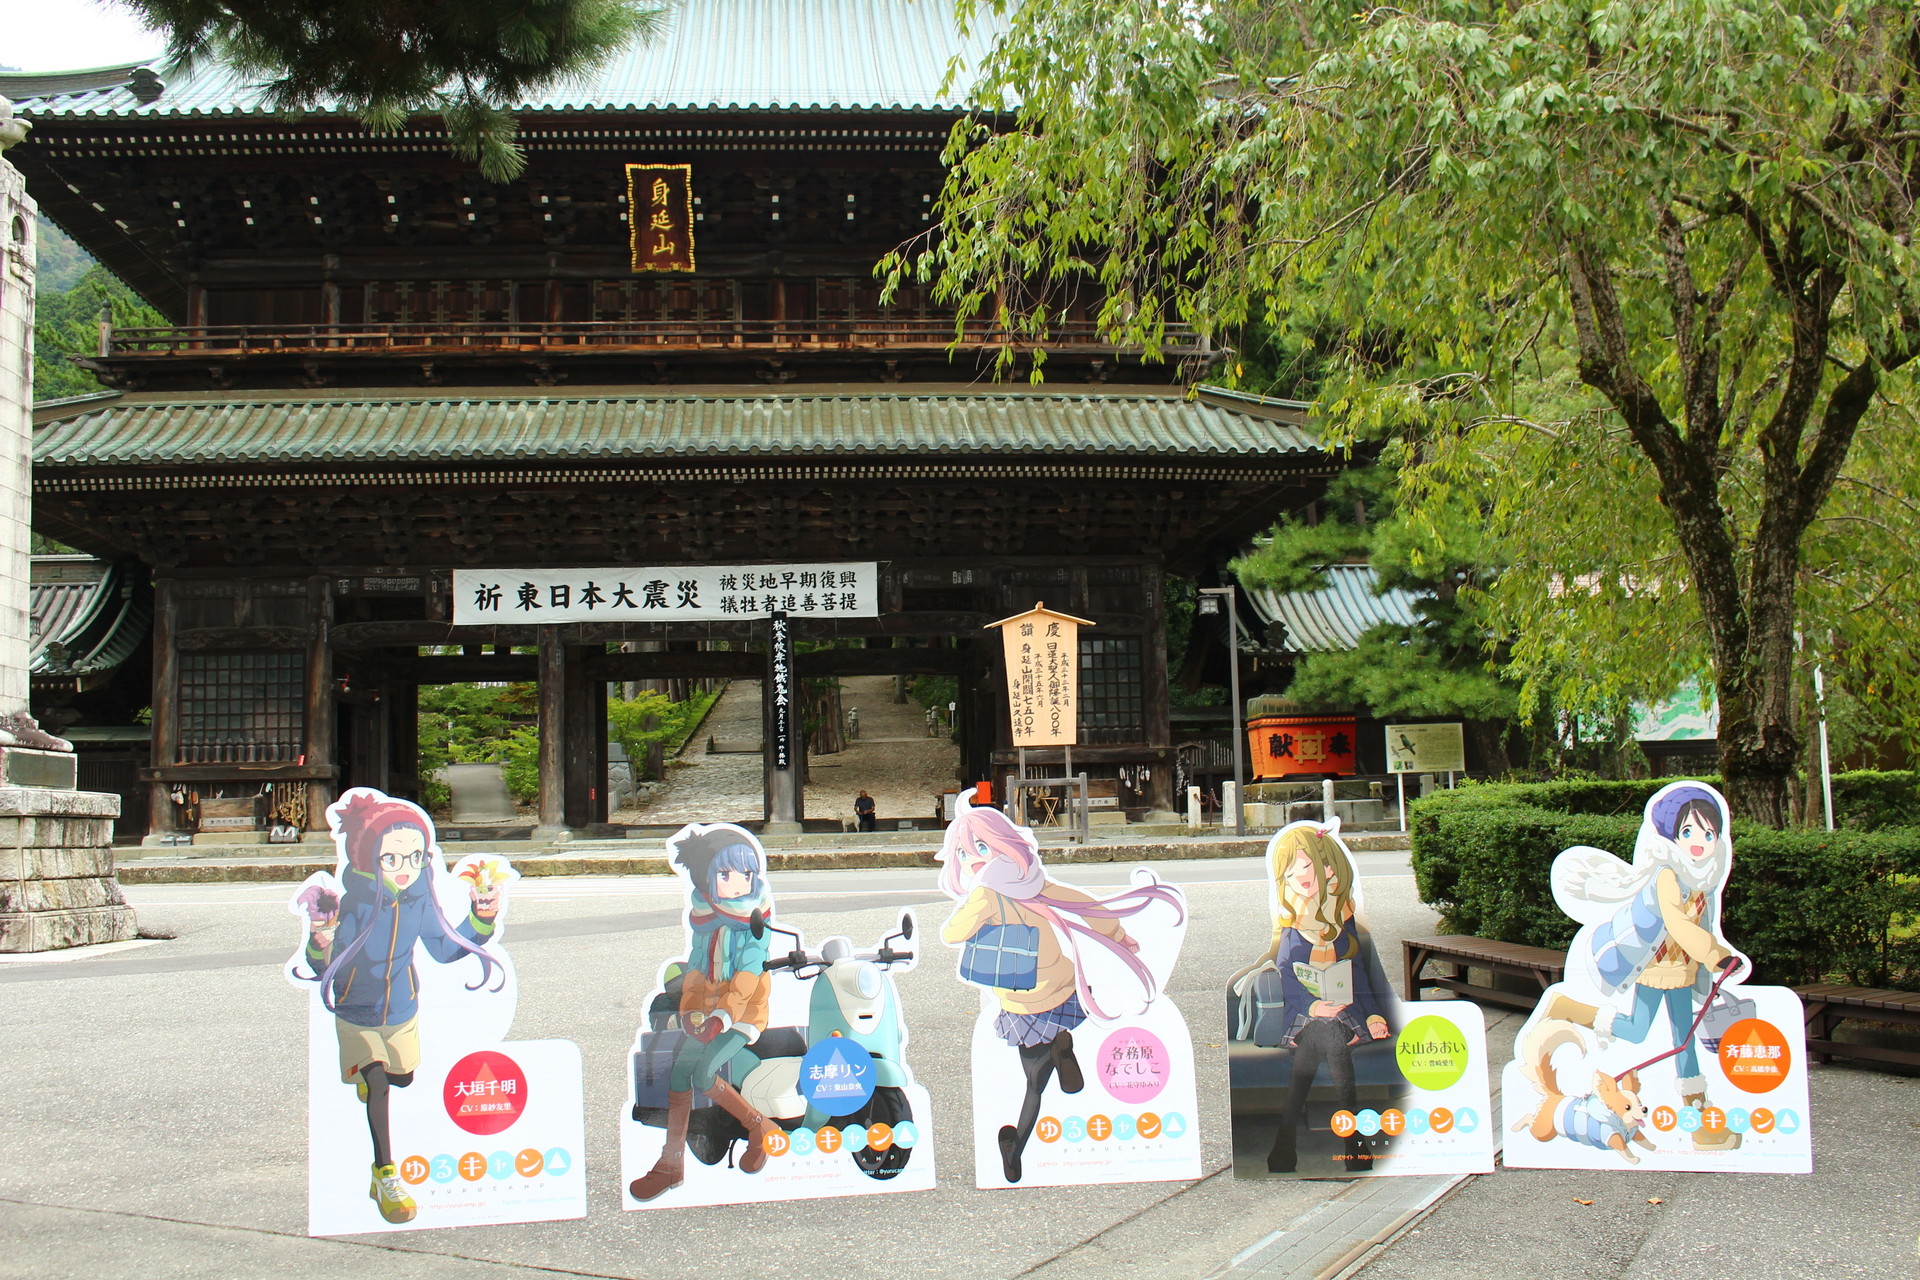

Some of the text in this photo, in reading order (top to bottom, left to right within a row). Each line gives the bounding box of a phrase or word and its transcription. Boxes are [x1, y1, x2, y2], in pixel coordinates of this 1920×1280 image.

[650, 177, 675, 256] 身延山
[719, 570, 857, 591] 被災地早期復興
[474, 579, 702, 612] 祈 東日本大震災
[1045, 622, 1061, 638] 慶
[1012, 678, 1023, 738] 身延山久遠寺
[1111, 1046, 1154, 1060] 各務原
[1398, 1041, 1466, 1055] 犬山あおい
[1725, 1044, 1782, 1059] 斉藤恵那
[809, 1063, 867, 1080] 志摩リン
[1105, 1062, 1161, 1076] なでしこ
[454, 1079, 517, 1098] 大垣千明
